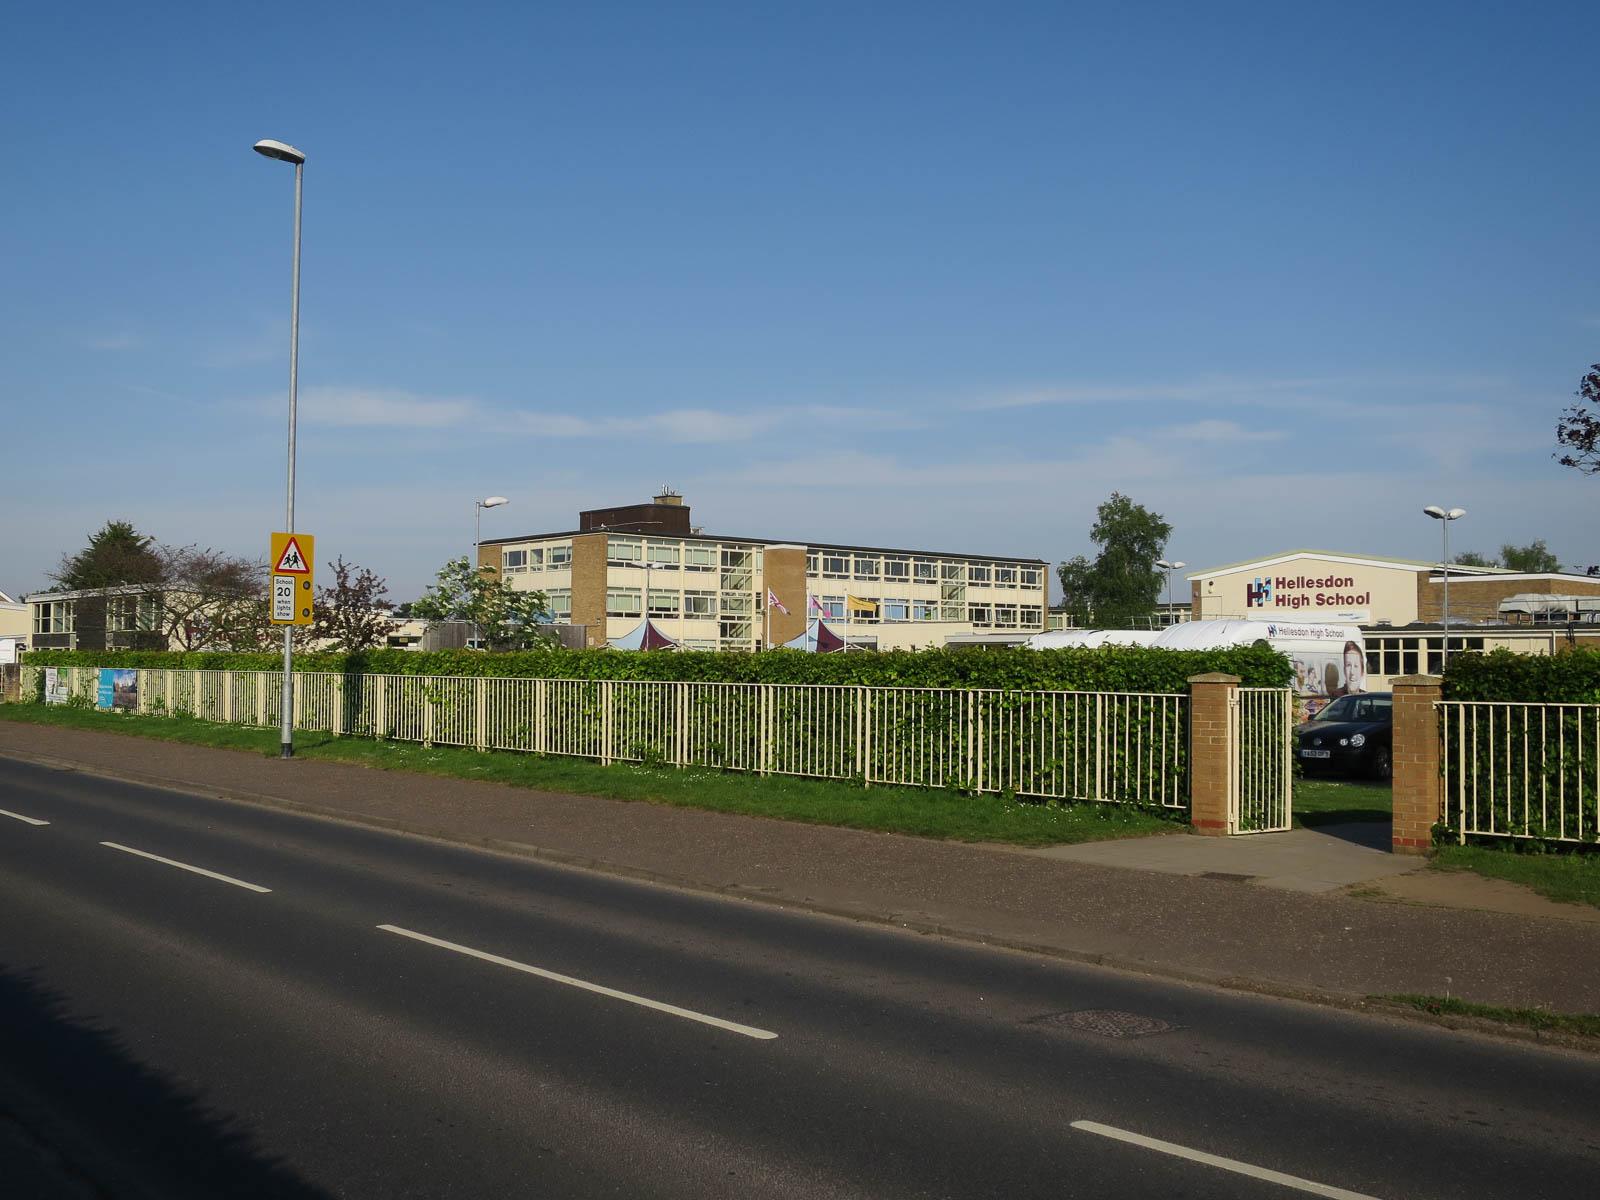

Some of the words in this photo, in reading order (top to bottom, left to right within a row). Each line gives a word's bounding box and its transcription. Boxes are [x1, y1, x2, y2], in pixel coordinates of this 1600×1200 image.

[1275, 575, 1354, 589] Hellesdon
[277, 587, 291, 597] 20
[1275, 594, 1310, 609] High
[1315, 592, 1370, 606] School
[1279, 627, 1309, 636] Hellesdon
[1310, 628, 1324, 639] High
[1325, 628, 1344, 638] School
